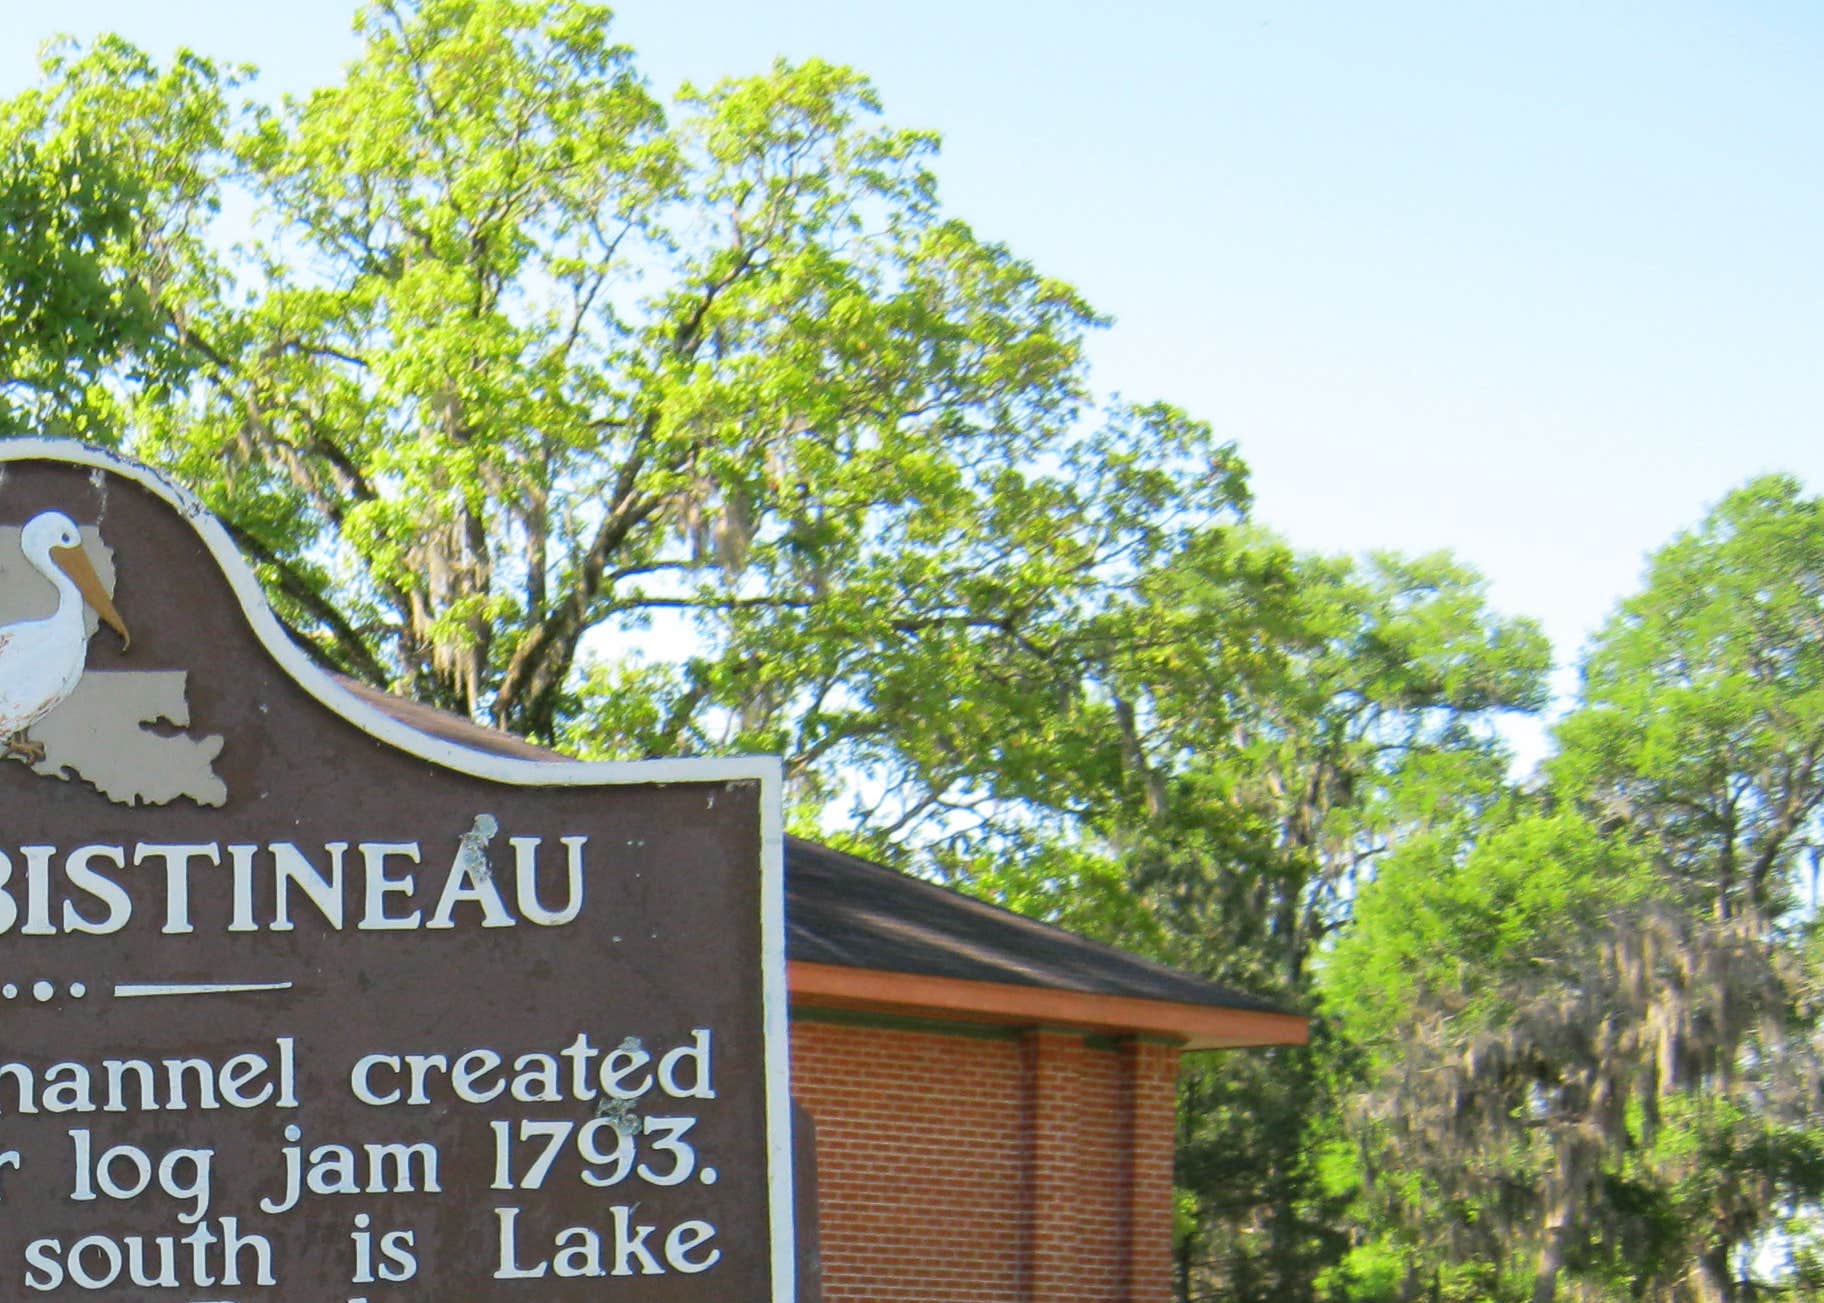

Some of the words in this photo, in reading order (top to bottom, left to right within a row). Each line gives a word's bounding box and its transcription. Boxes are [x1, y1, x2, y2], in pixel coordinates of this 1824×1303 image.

[351, 1028, 716, 1106] created
[68, 1129, 215, 1224] log
[259, 1124, 442, 1213] jam
[490, 1115, 717, 1190] 1793.
[24, 1216, 277, 1291] south
[350, 1213, 417, 1283] is
[493, 1205, 721, 1279] Lake
